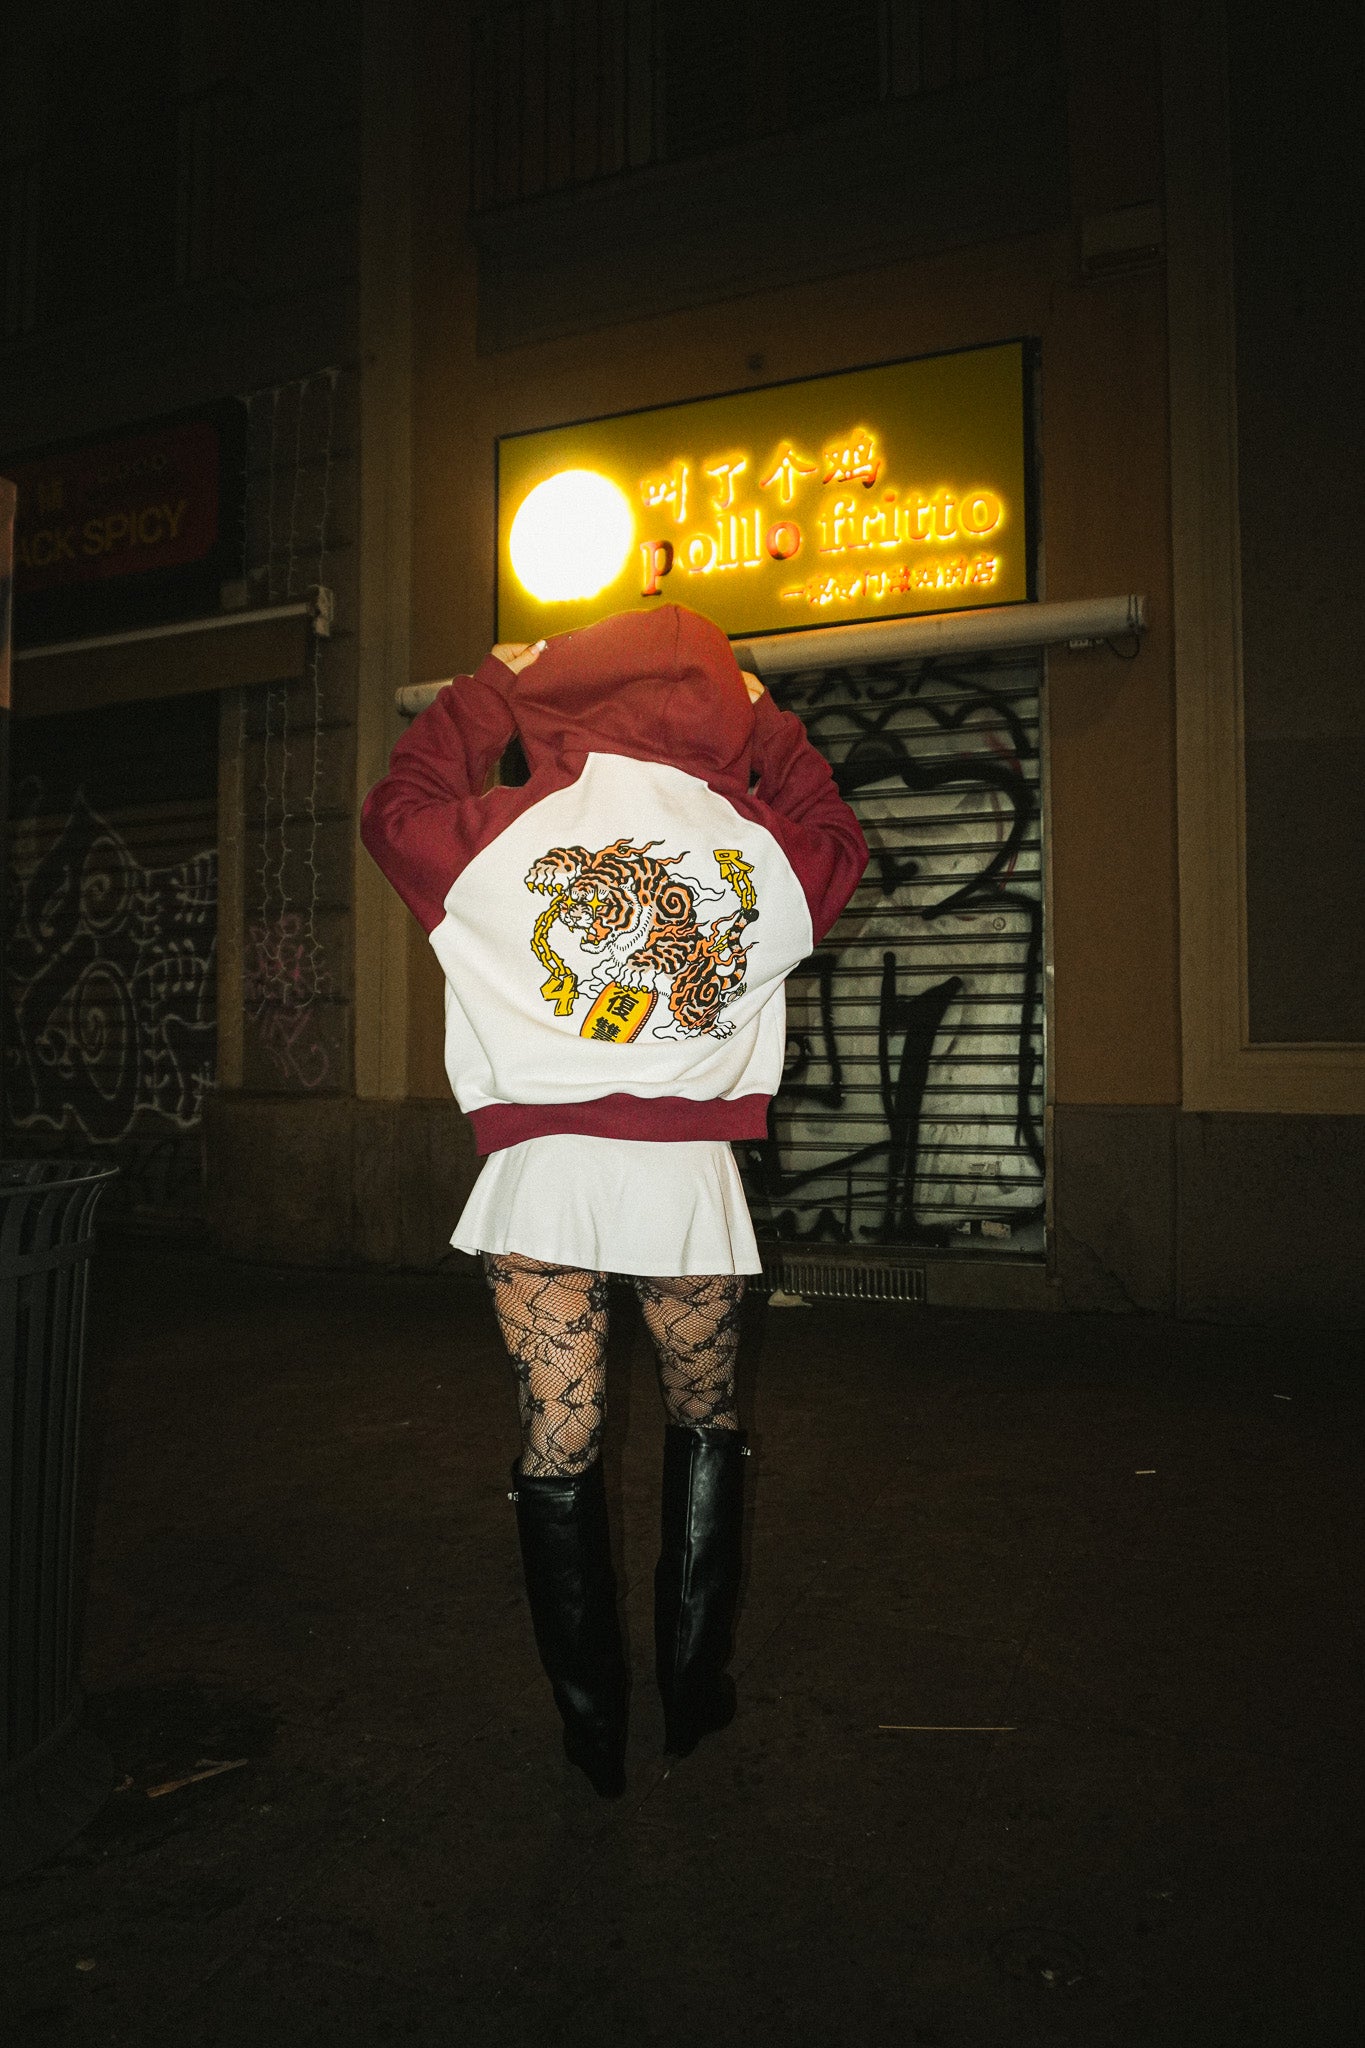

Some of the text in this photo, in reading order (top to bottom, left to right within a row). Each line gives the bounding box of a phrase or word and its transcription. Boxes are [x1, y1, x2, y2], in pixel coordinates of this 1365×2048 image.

[640, 427, 881, 523] 叫了个鸡
[83, 500, 187, 556] SPICY
[640, 488, 1001, 597] pollo fritto
[713, 849, 754, 879] R
[540, 973, 578, 1016] 4
